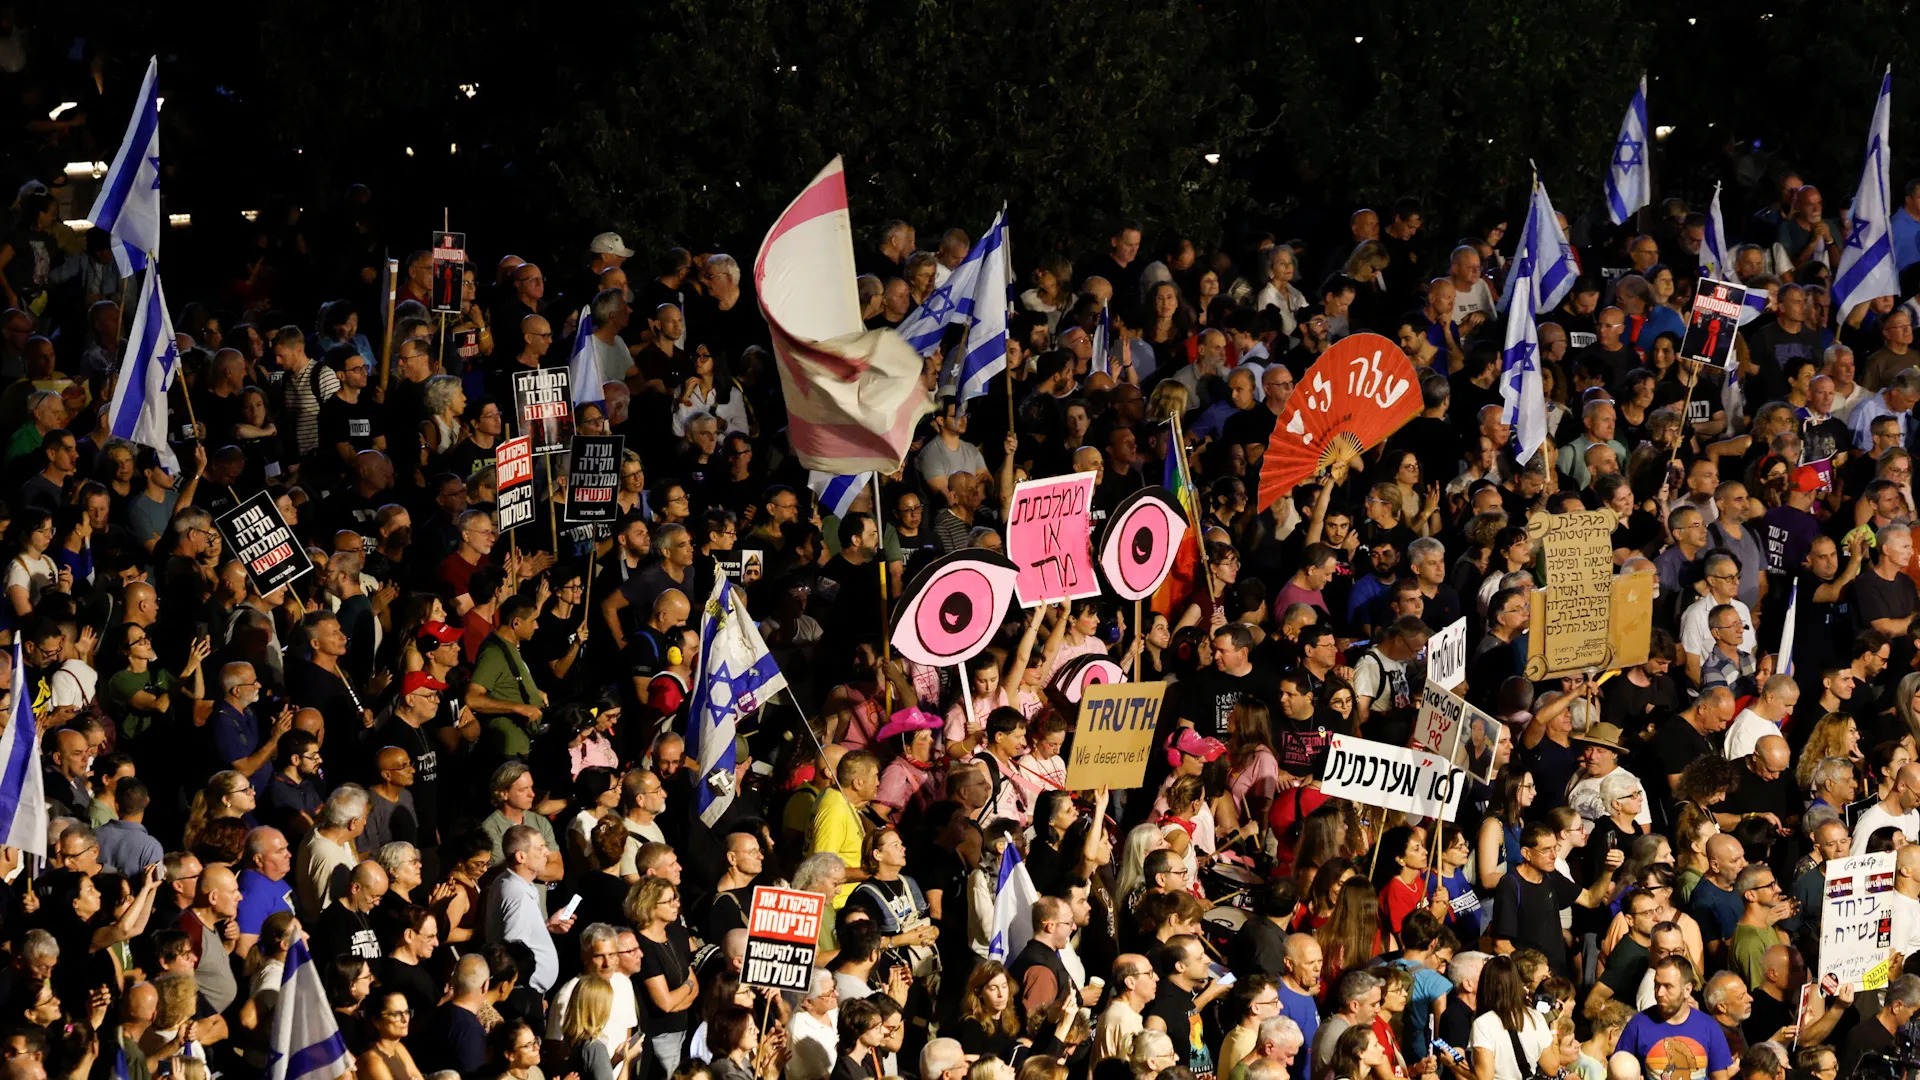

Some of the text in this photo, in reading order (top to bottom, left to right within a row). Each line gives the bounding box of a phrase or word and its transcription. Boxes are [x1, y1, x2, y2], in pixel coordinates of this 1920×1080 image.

[518, 373, 567, 391] ממשלת
[584, 444, 613, 457] ועדת
[578, 457, 614, 473] חקירה
[570, 472, 617, 486] ממלכתית
[575, 488, 612, 502] עכשיו!
[1012, 485, 1084, 525] ממלכתית
[232, 505, 264, 532] ועדת
[1552, 514, 1605, 531] מגילת
[235, 515, 276, 547] חקירה
[1044, 519, 1061, 555] או
[1548, 528, 1610, 542] הדיקטטורה
[238, 527, 290, 565] ממלכתית
[1547, 545, 1611, 558] רשע ופשע
[251, 542, 294, 575] עכשיו!
[1584, 556, 1613, 567] שנאה
[1031, 553, 1078, 592] מרד
[1551, 568, 1611, 583] גזל וביזה
[1553, 582, 1611, 600] אש ואסון
[1552, 607, 1606, 623] סרבנות
[1546, 623, 1581, 635] החיילים
[1427, 710, 1452, 732] עדיין
[1075, 746, 1091, 765] We
[1093, 746, 1135, 764] deserve
[759, 892, 819, 914] הפקרת את
[1831, 897, 1881, 917] ביחד
[754, 909, 818, 938] הביטחון
[749, 941, 813, 965] כדי להישאר
[746, 958, 808, 988] בשלטון
